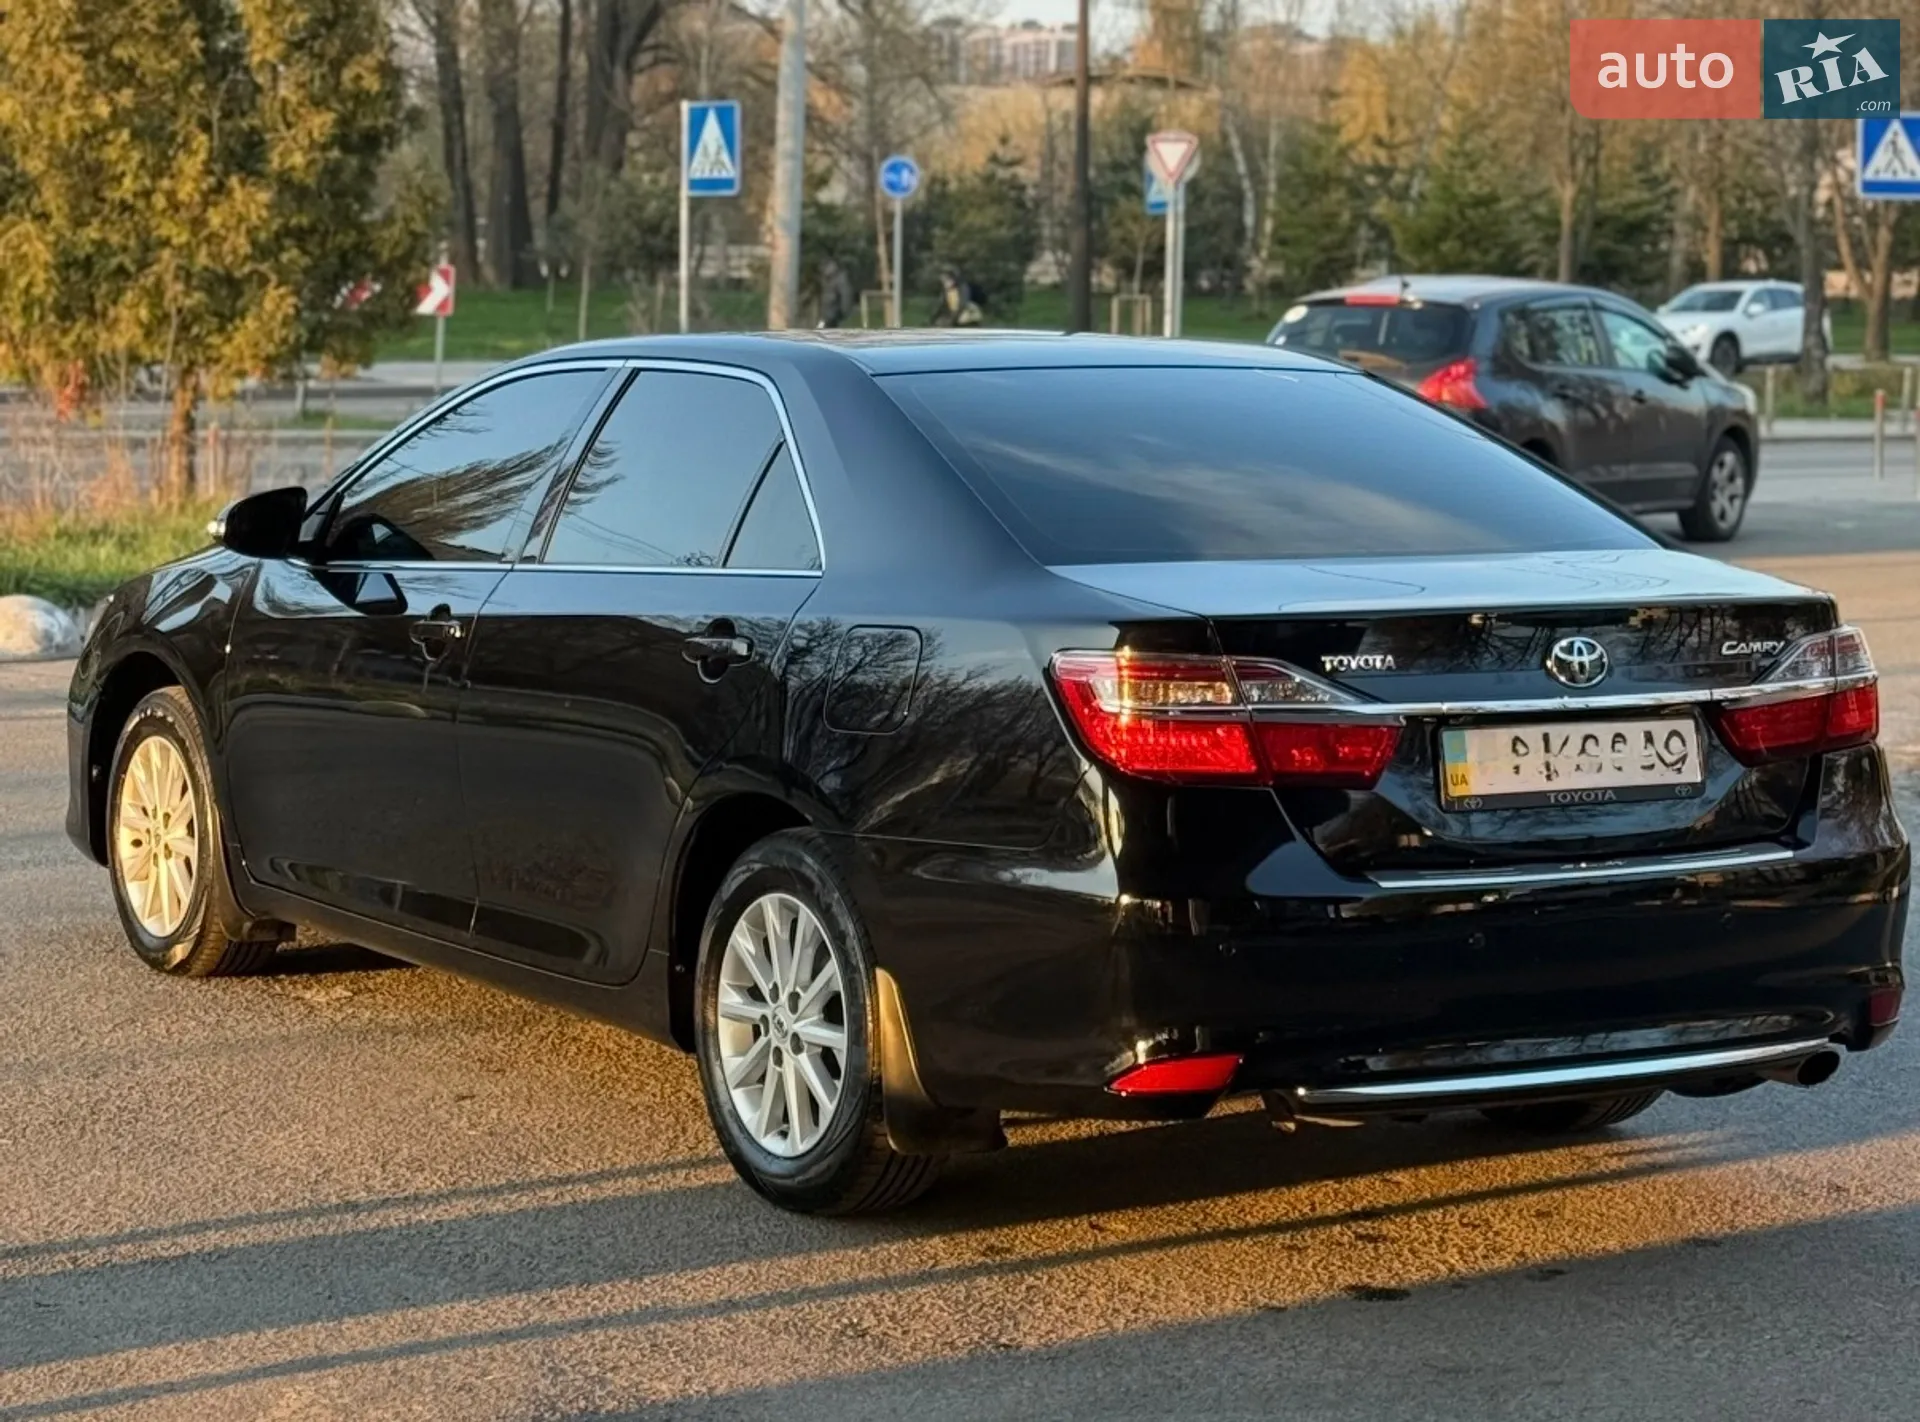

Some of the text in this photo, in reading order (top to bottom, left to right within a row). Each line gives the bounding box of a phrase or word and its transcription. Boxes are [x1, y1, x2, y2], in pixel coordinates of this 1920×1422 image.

[1321, 654, 1397, 672] TOYOTA
[1450, 773, 1469, 788] UA
[1546, 788, 1618, 804] TOYOTA
